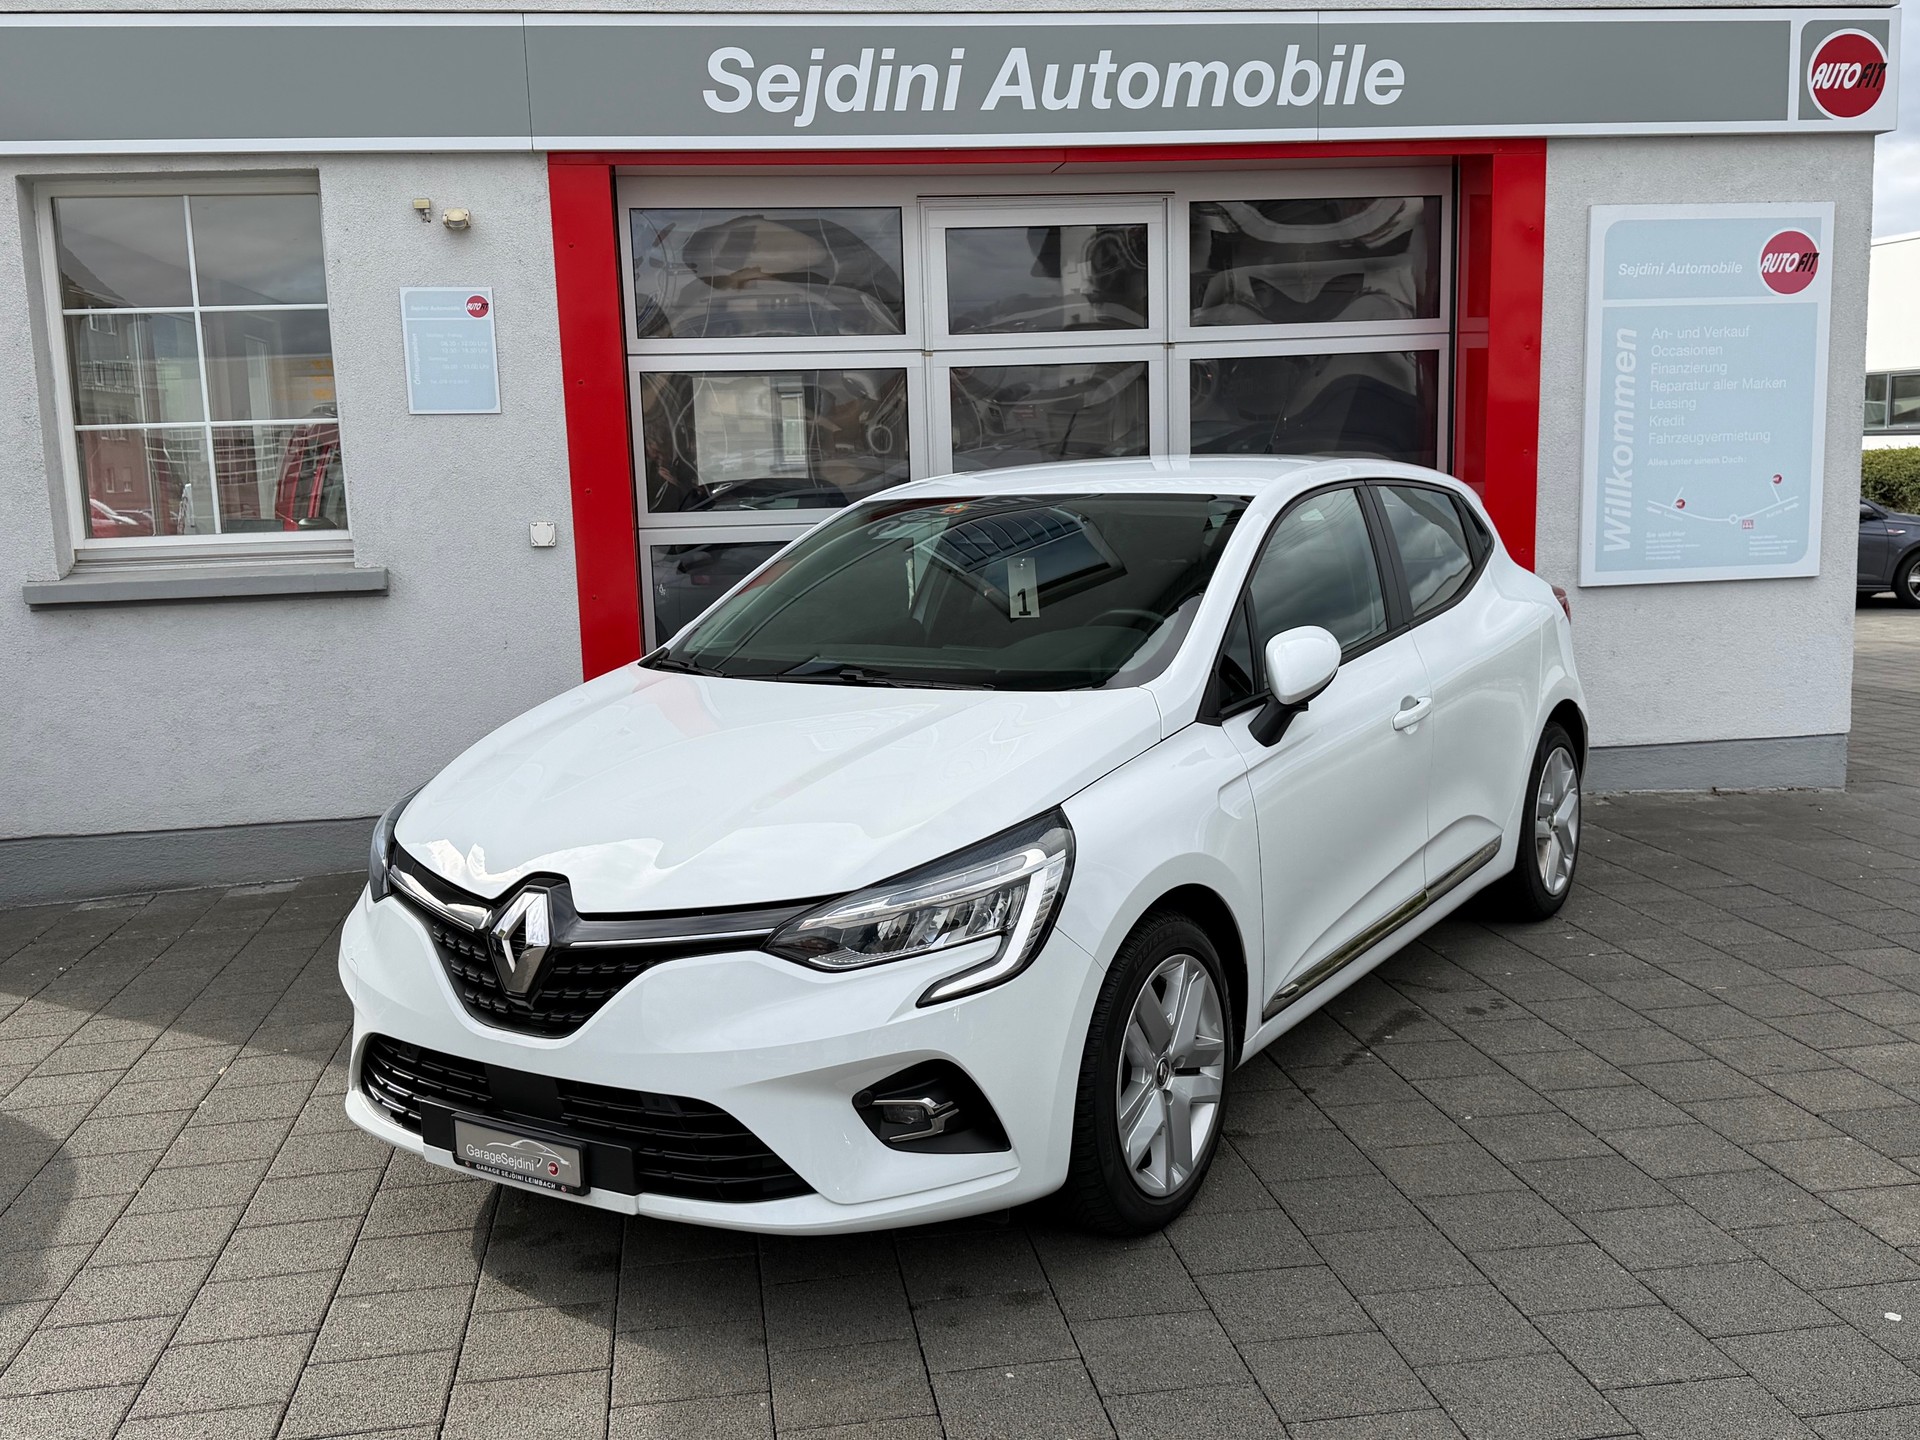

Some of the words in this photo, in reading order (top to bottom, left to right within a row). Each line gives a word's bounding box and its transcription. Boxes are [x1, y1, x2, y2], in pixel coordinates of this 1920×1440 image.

[1812, 62, 1888, 89] AUTOFIT
[703, 46, 965, 128] Sejdini
[980, 44, 1405, 110] Automobile
[1618, 263, 1663, 278] Sejdini
[1666, 261, 1743, 275] Automobile
[1761, 252, 1819, 273] AUTOFIT
[1651, 327, 1673, 339] An-
[1677, 326, 1700, 338] und
[1703, 325, 1751, 338] Verkauf
[1651, 344, 1724, 357] Occasionen
[1650, 361, 1728, 376] Finanzierung
[1650, 380, 1709, 395] Reparatur
[1713, 380, 1740, 391] aller
[1743, 378, 1787, 390] Marken
[1650, 398, 1697, 413] Leasing
[1649, 414, 1685, 427] Kredit
[1603, 328, 1636, 552] Willkommen
[1648, 431, 1771, 446] Fahrzeugvermietung
[1647, 458, 1669, 467] Alles
[1017, 588, 1032, 616] 1
[466, 1144, 534, 1171] GarageSejdini
